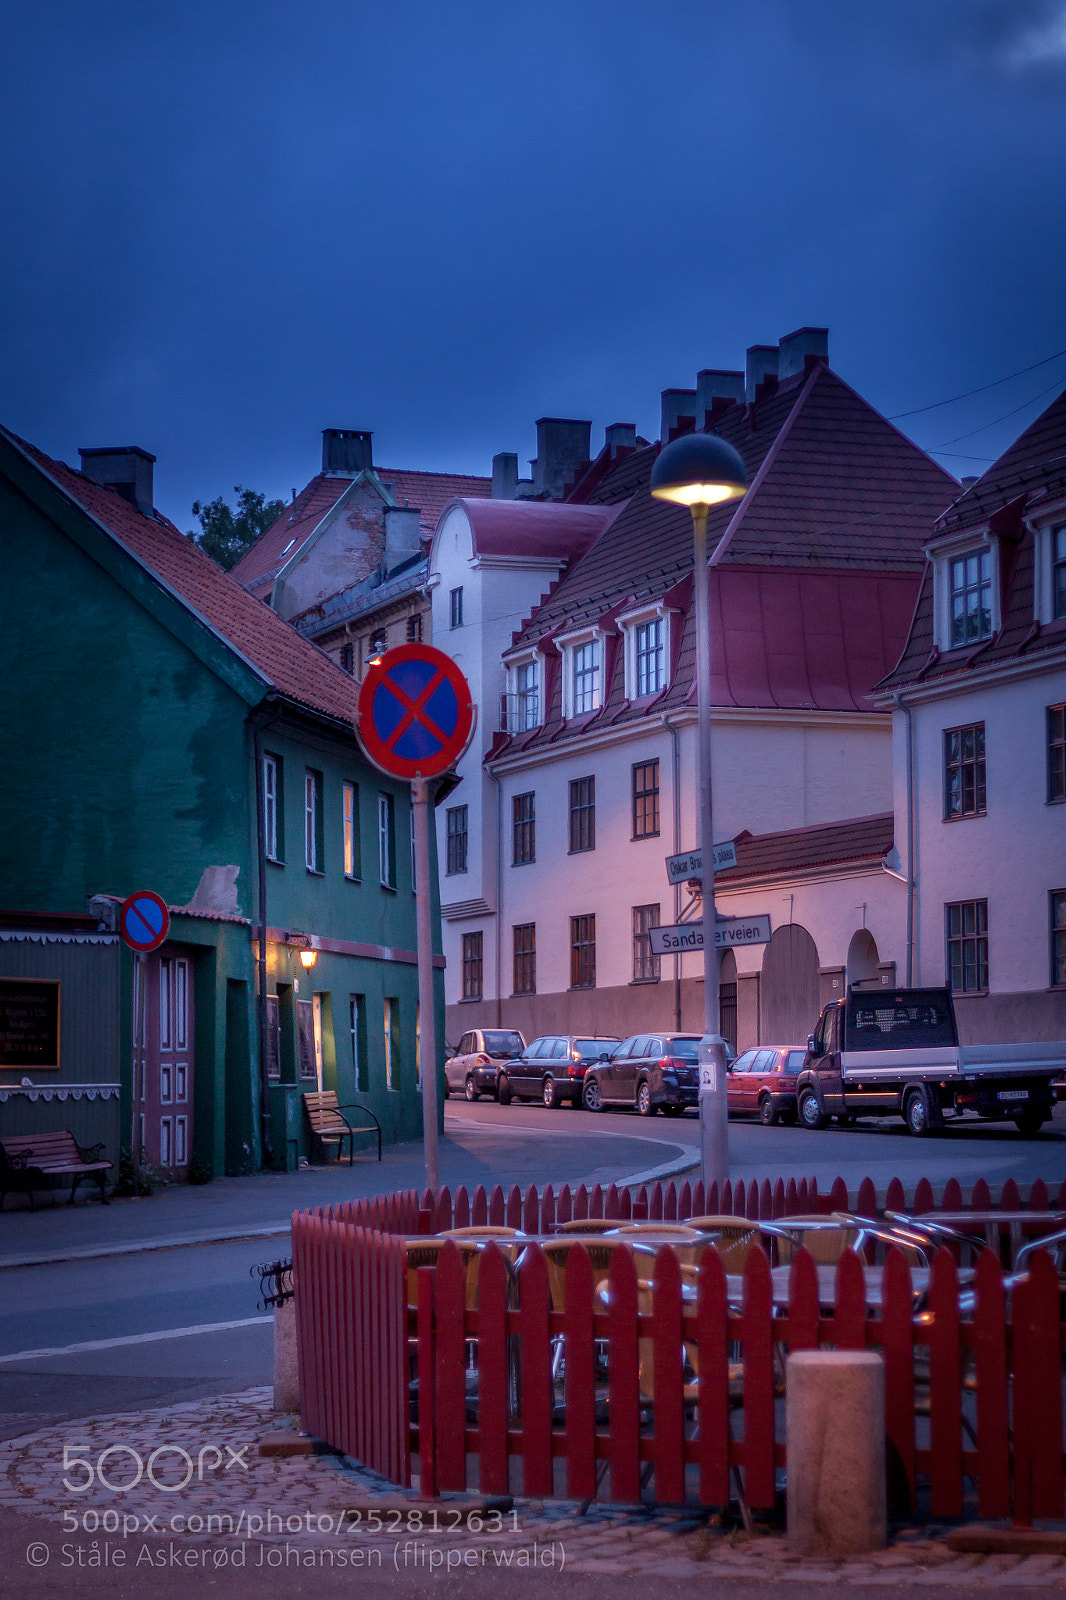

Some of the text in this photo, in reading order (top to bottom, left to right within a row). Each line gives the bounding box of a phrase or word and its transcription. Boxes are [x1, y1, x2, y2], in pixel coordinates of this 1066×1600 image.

[669, 859, 688, 876] Oskar
[718, 848, 734, 865] plass
[662, 925, 760, 948] Sandaerveien
